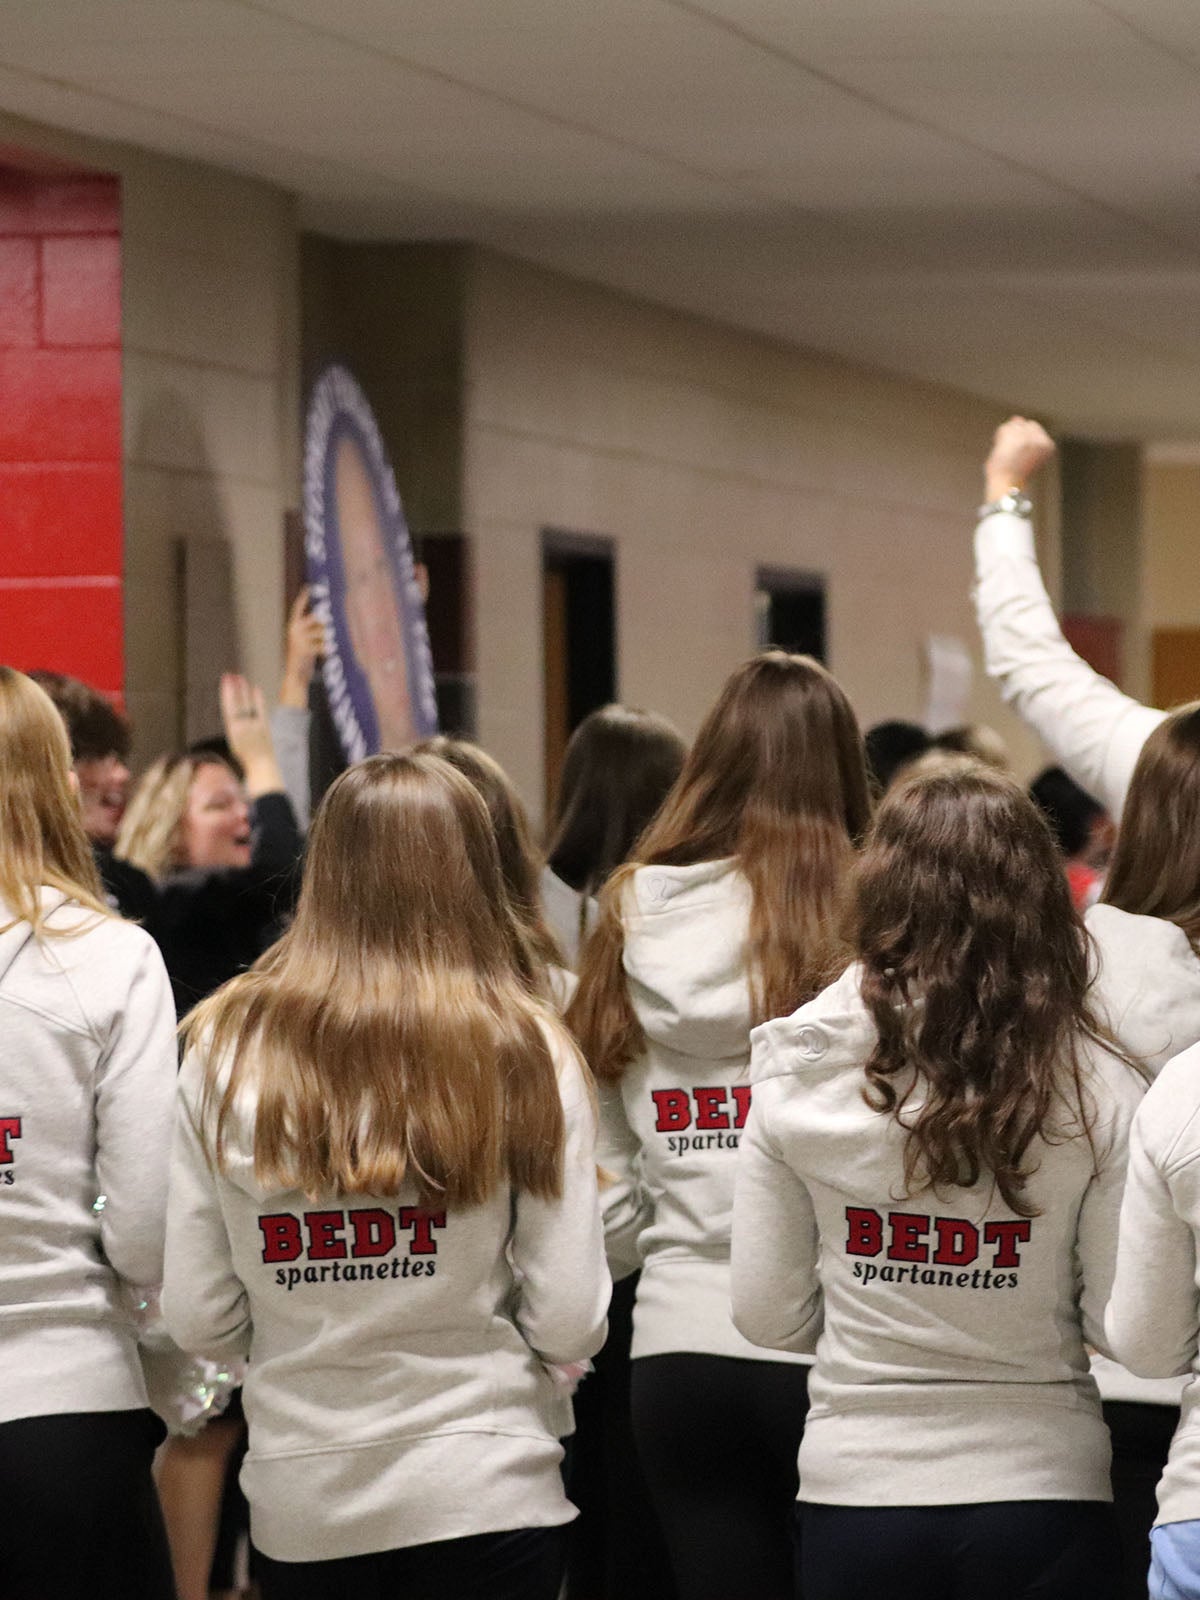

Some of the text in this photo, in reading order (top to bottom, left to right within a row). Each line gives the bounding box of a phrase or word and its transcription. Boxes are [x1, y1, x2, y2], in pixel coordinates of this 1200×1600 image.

[668, 1132, 742, 1157] sparta
[258, 1206, 448, 1265] BEDT
[845, 1206, 1032, 1269] BEDT
[275, 1257, 436, 1291] spartanettes
[852, 1261, 1018, 1290] spartanettes
